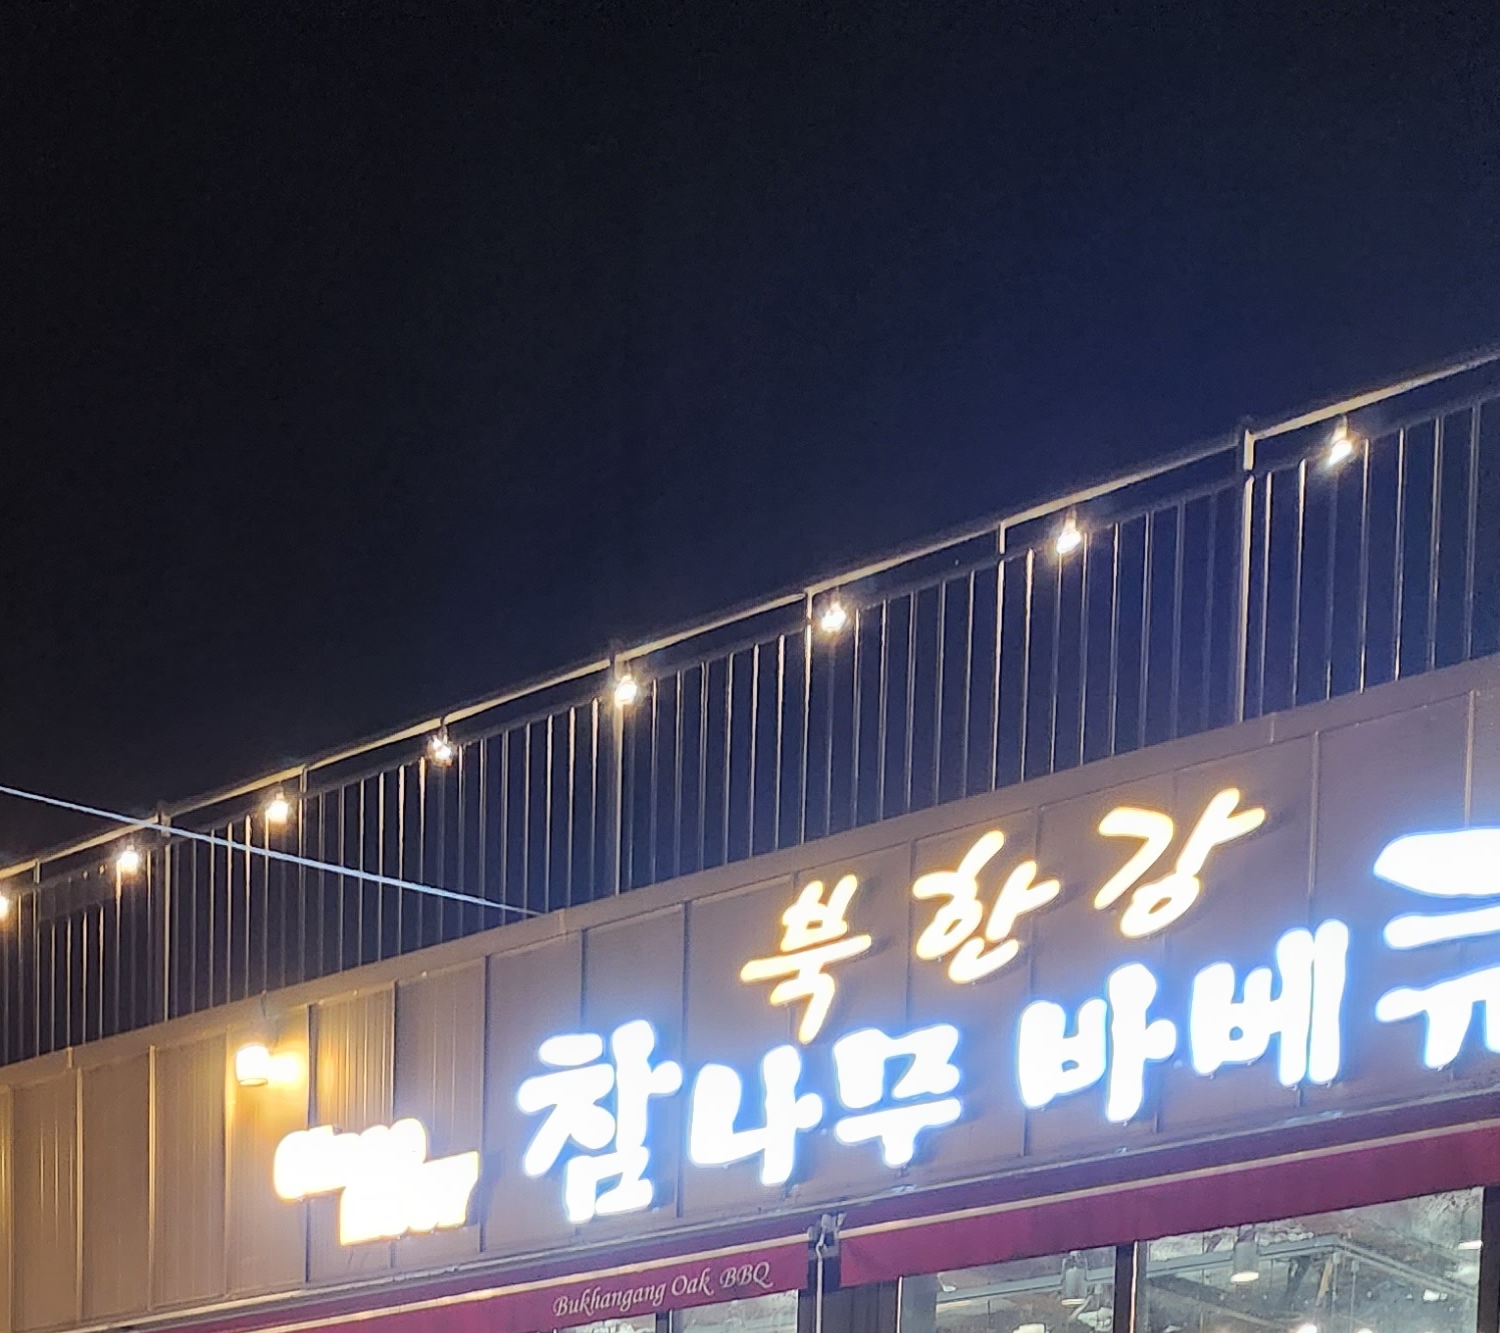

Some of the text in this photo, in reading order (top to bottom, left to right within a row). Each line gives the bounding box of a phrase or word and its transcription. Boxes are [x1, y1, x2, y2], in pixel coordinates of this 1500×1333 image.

[517, 1019, 962, 1224] 참나무
[553, 1261, 774, 1316] Bukhangang Oak BBQ
